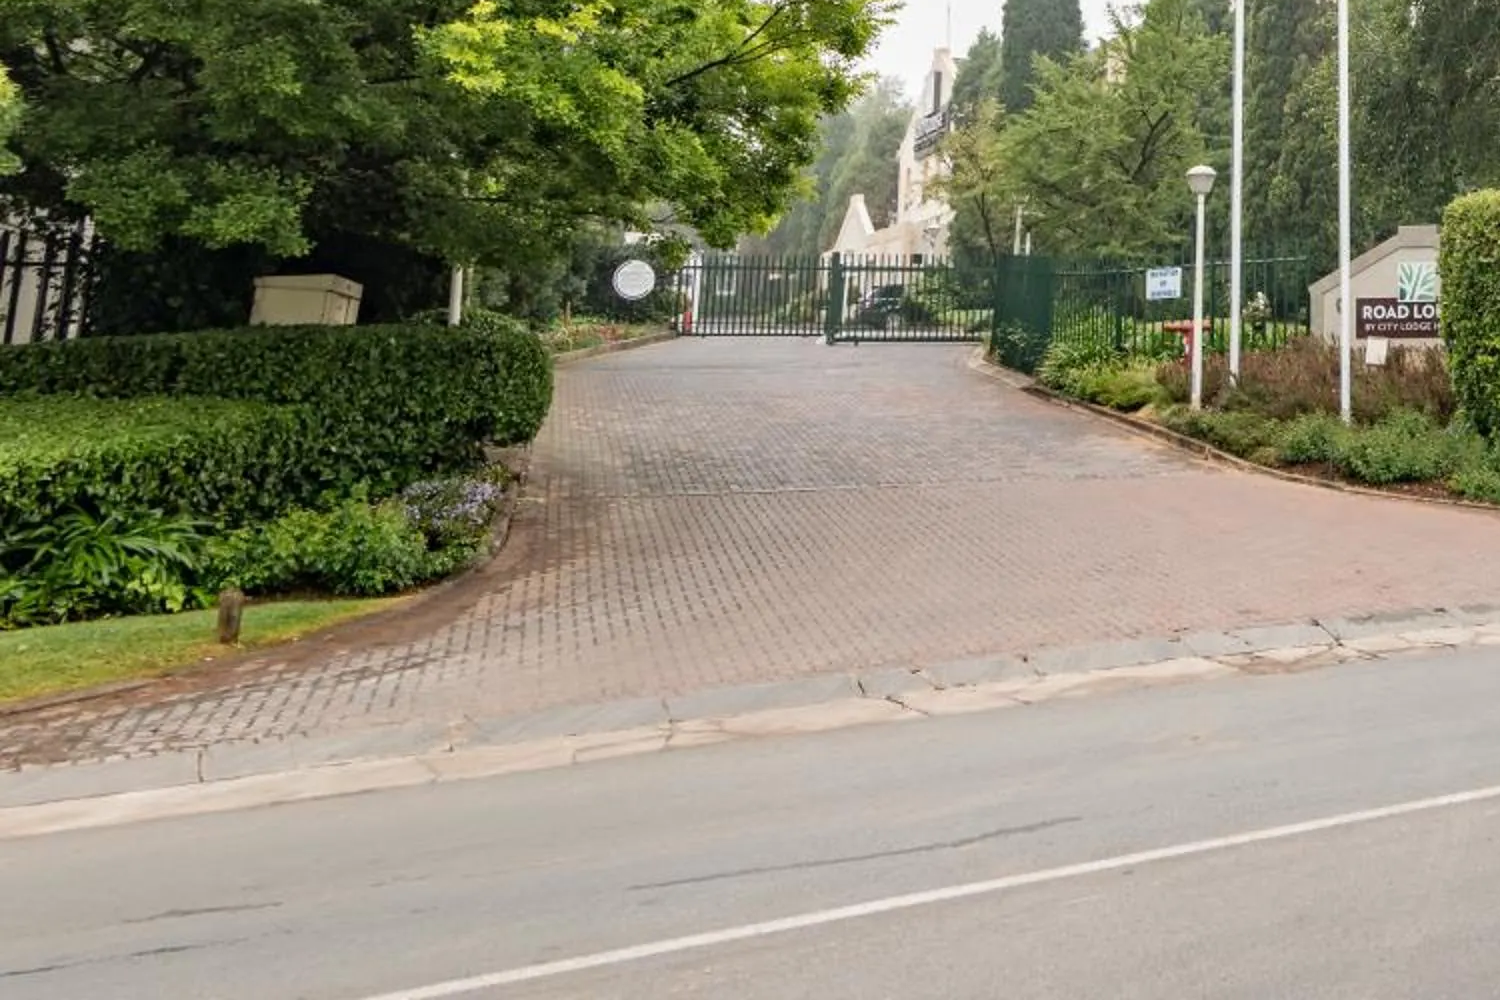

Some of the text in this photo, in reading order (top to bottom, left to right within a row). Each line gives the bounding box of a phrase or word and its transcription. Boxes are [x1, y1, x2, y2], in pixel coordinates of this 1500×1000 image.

[1362, 304, 1410, 320] ROAD
[1365, 323, 1376, 331] BY
[1377, 322, 1399, 331] CITY
[1400, 321, 1431, 331] LODGE
